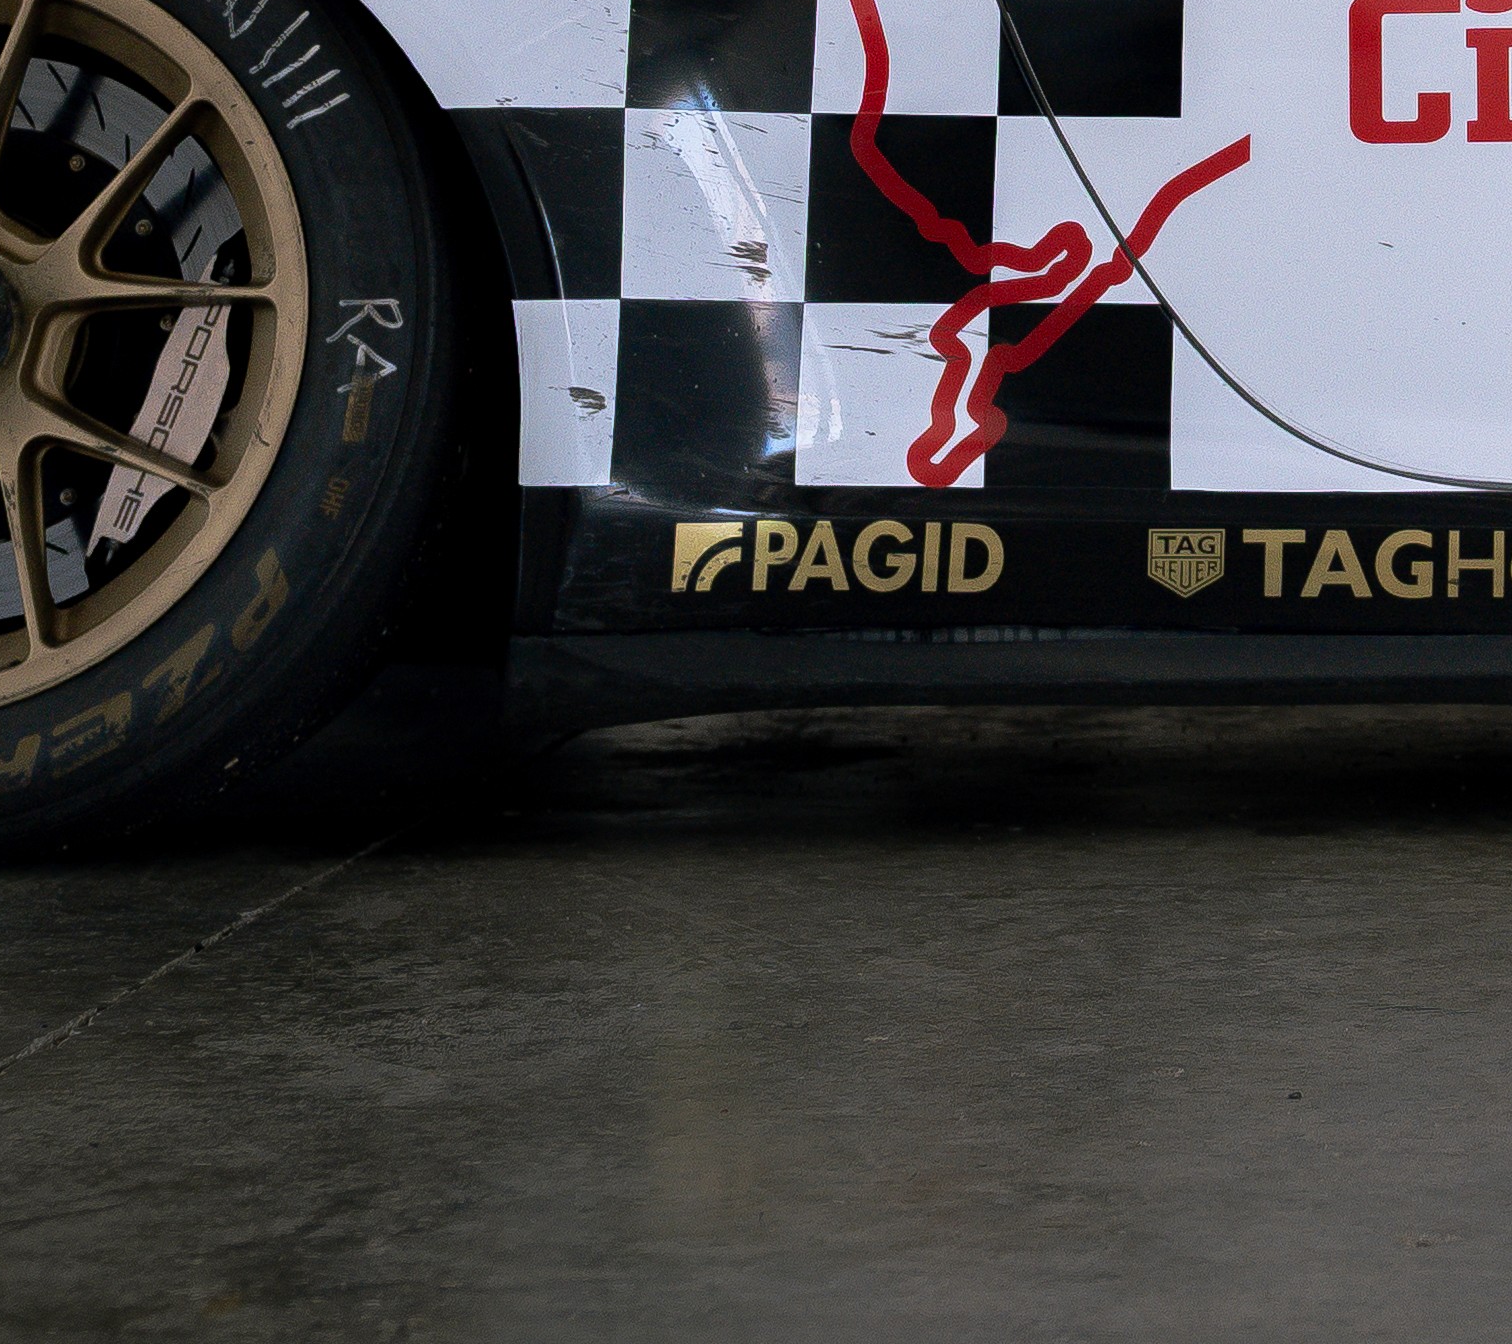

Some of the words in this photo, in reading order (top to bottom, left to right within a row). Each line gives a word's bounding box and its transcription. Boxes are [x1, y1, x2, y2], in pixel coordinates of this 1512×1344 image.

[752, 519, 1006, 593] PAGID
[1156, 535, 1217, 555] TAG
[231, 546, 289, 652] P
[1152, 558, 1219, 588] HEUER
